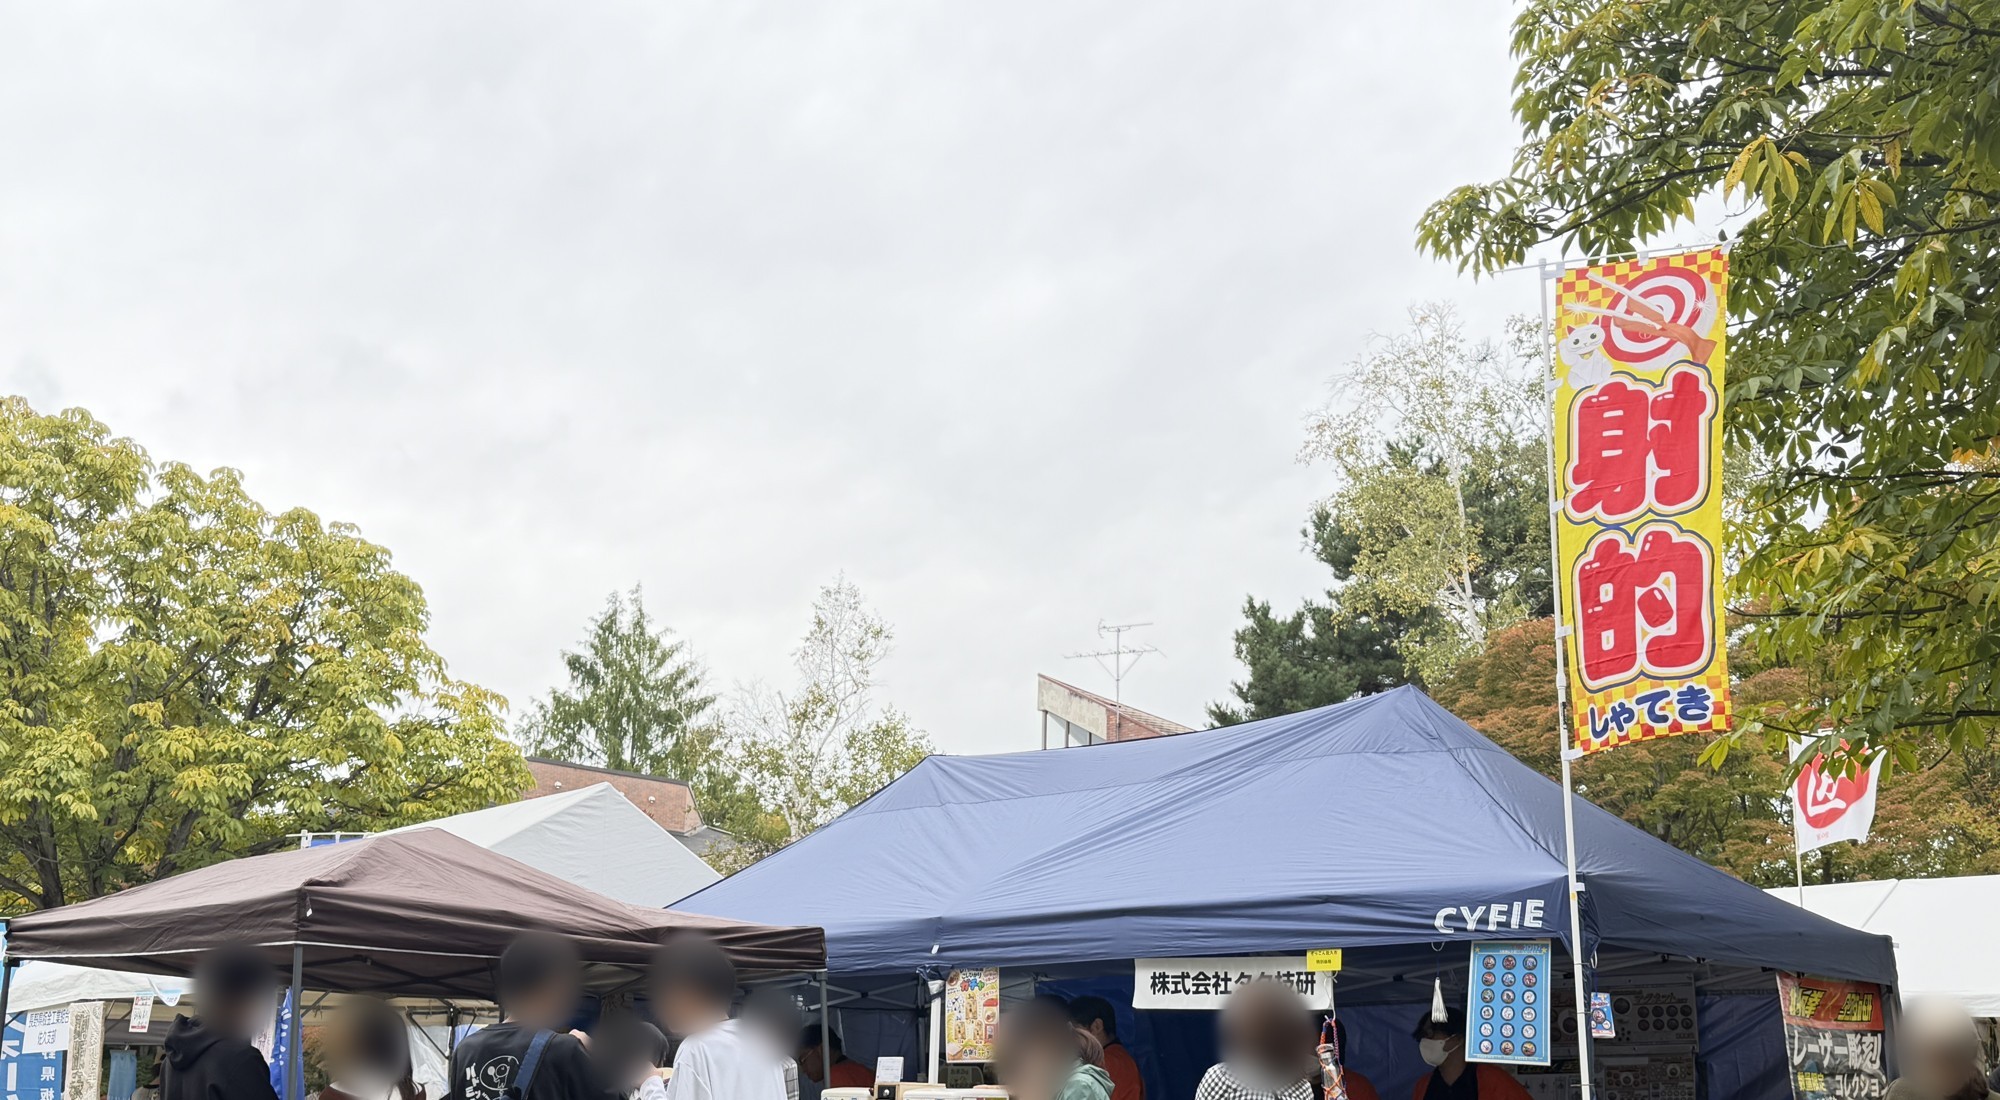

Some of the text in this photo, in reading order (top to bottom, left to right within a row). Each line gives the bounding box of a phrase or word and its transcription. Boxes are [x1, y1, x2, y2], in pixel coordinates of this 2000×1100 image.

[1571, 370, 1711, 681] 射的
[1589, 685, 1713, 739] しゃてき
[1434, 899, 1545, 934] CYFIE
[1793, 1030, 1882, 1070] レーザー彫刻
